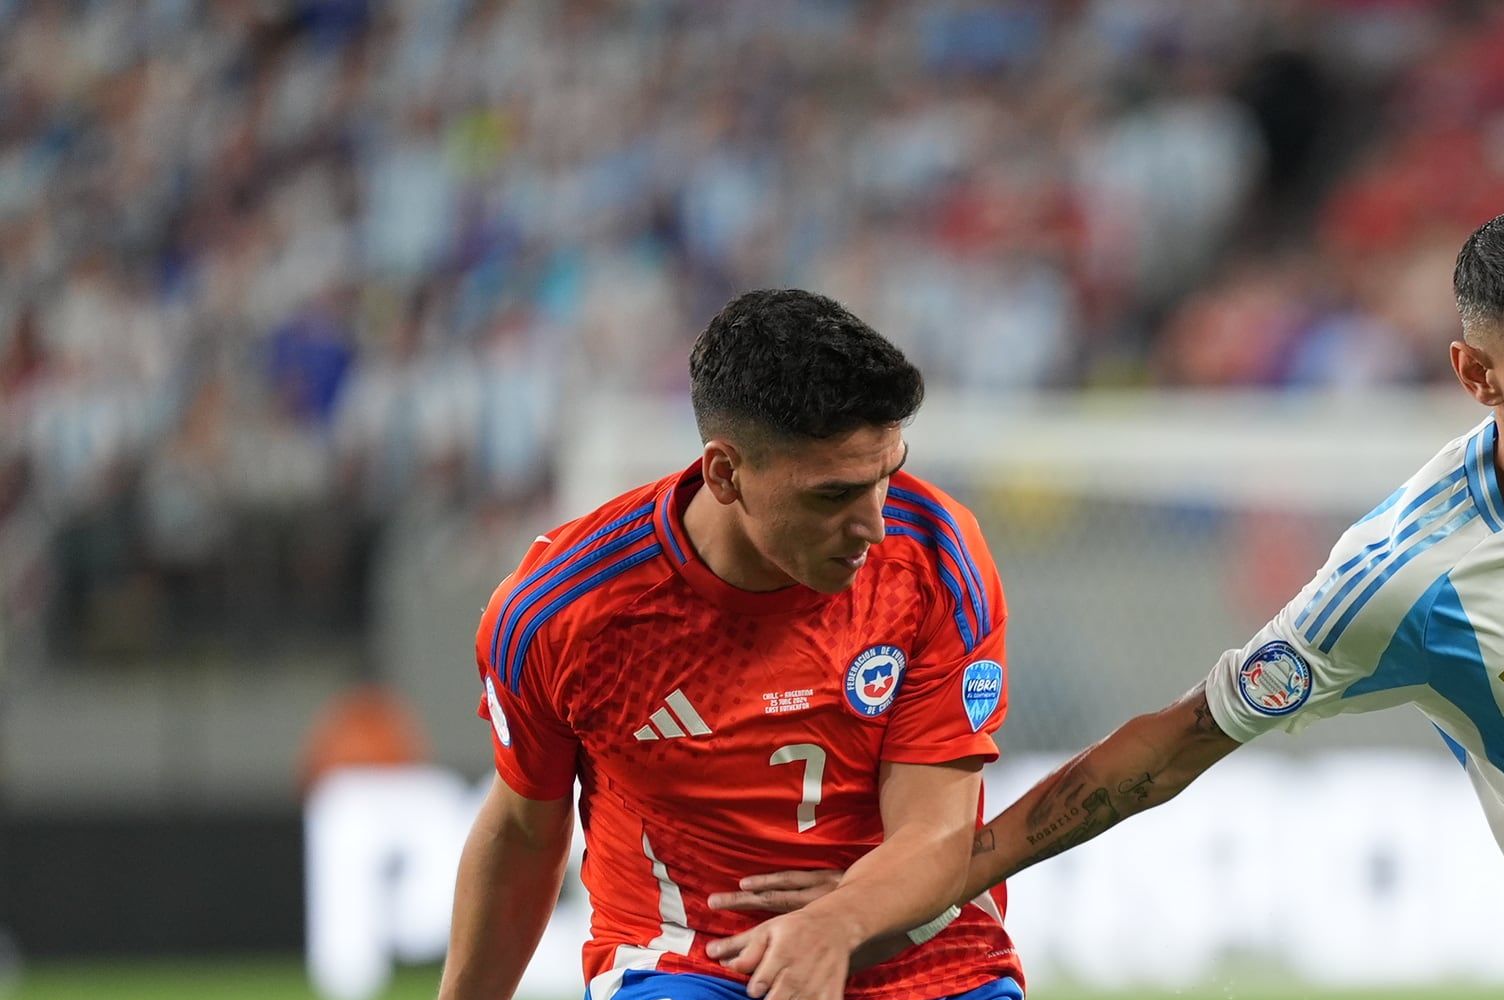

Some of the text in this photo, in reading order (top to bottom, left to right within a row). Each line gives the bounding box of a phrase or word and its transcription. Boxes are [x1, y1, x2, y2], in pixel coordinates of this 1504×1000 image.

[847, 647, 876, 691] FEDERACION
[881, 646, 890, 655] DE
[968, 679, 997, 692] VIBRA
[866, 706, 876, 714] DE
[769, 743, 826, 833] 7
[1026, 807, 1079, 846] Rosario
